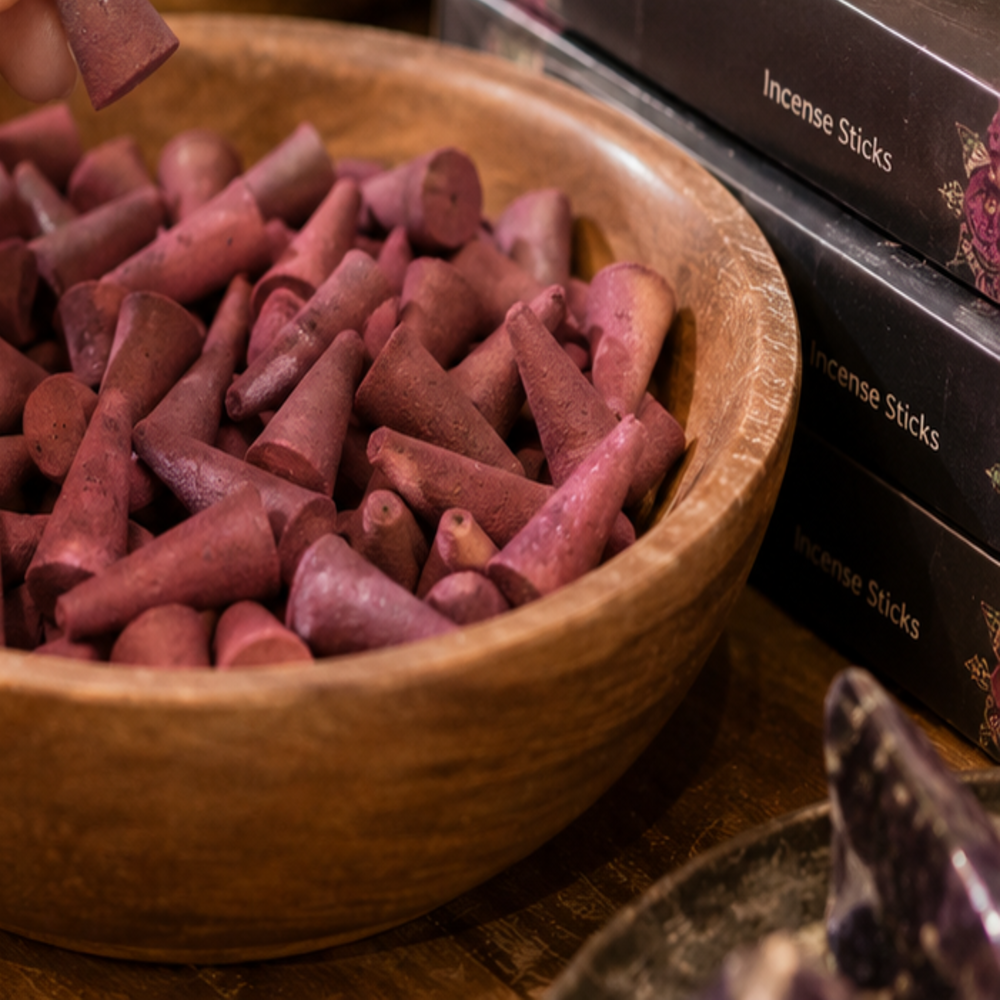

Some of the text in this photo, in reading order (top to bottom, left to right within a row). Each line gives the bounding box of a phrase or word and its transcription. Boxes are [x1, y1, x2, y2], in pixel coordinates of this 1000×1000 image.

[763, 68, 893, 173] Incense Sticks
[810, 339, 940, 451] Incense Sticks
[794, 524, 920, 640] Incense Sticks
